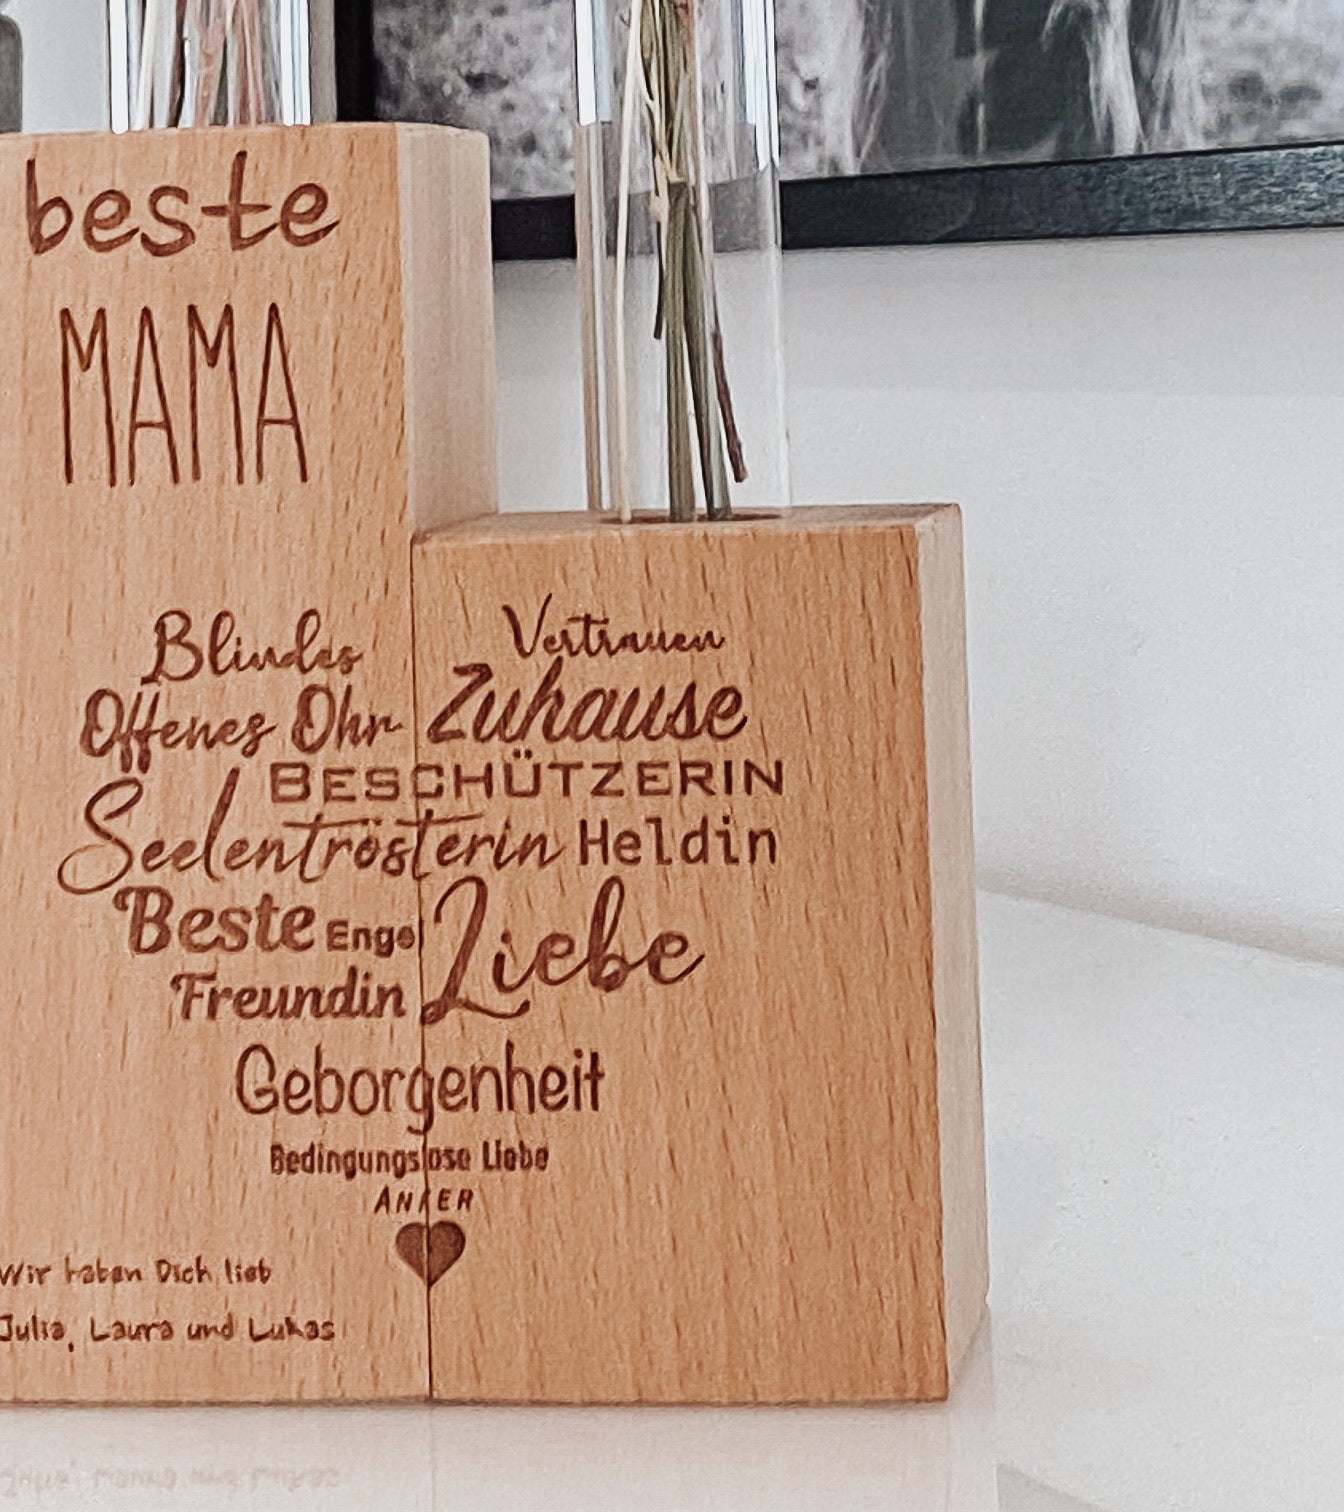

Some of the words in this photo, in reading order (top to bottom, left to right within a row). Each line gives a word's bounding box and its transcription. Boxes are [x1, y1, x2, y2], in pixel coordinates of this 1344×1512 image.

[26, 149, 342, 257] beste
[59, 302, 309, 488] MAMA
[140, 608, 364, 686] Blindes
[502, 593, 725, 658] Vertrauen
[79, 688, 277, 774] Offenes
[291, 684, 404, 754] Ohr
[426, 655, 748, 744] Zuhause
[57, 766, 567, 895] Seelentrösterin
[578, 814, 777, 867] Heldin
[112, 885, 316, 955] Beste
[420, 875, 706, 1026] Liebe
[169, 964, 408, 1022] Freundin
[235, 1038, 606, 1136] Geborgenheit
[482, 1140, 550, 1174] Liebe
[156, 1253, 214, 1285] Dich
[224, 1256, 273, 1285] lieb
[89, 1315, 175, 1343] Laura
[187, 1314, 235, 1342] und
[248, 1315, 337, 1344] Lukas
